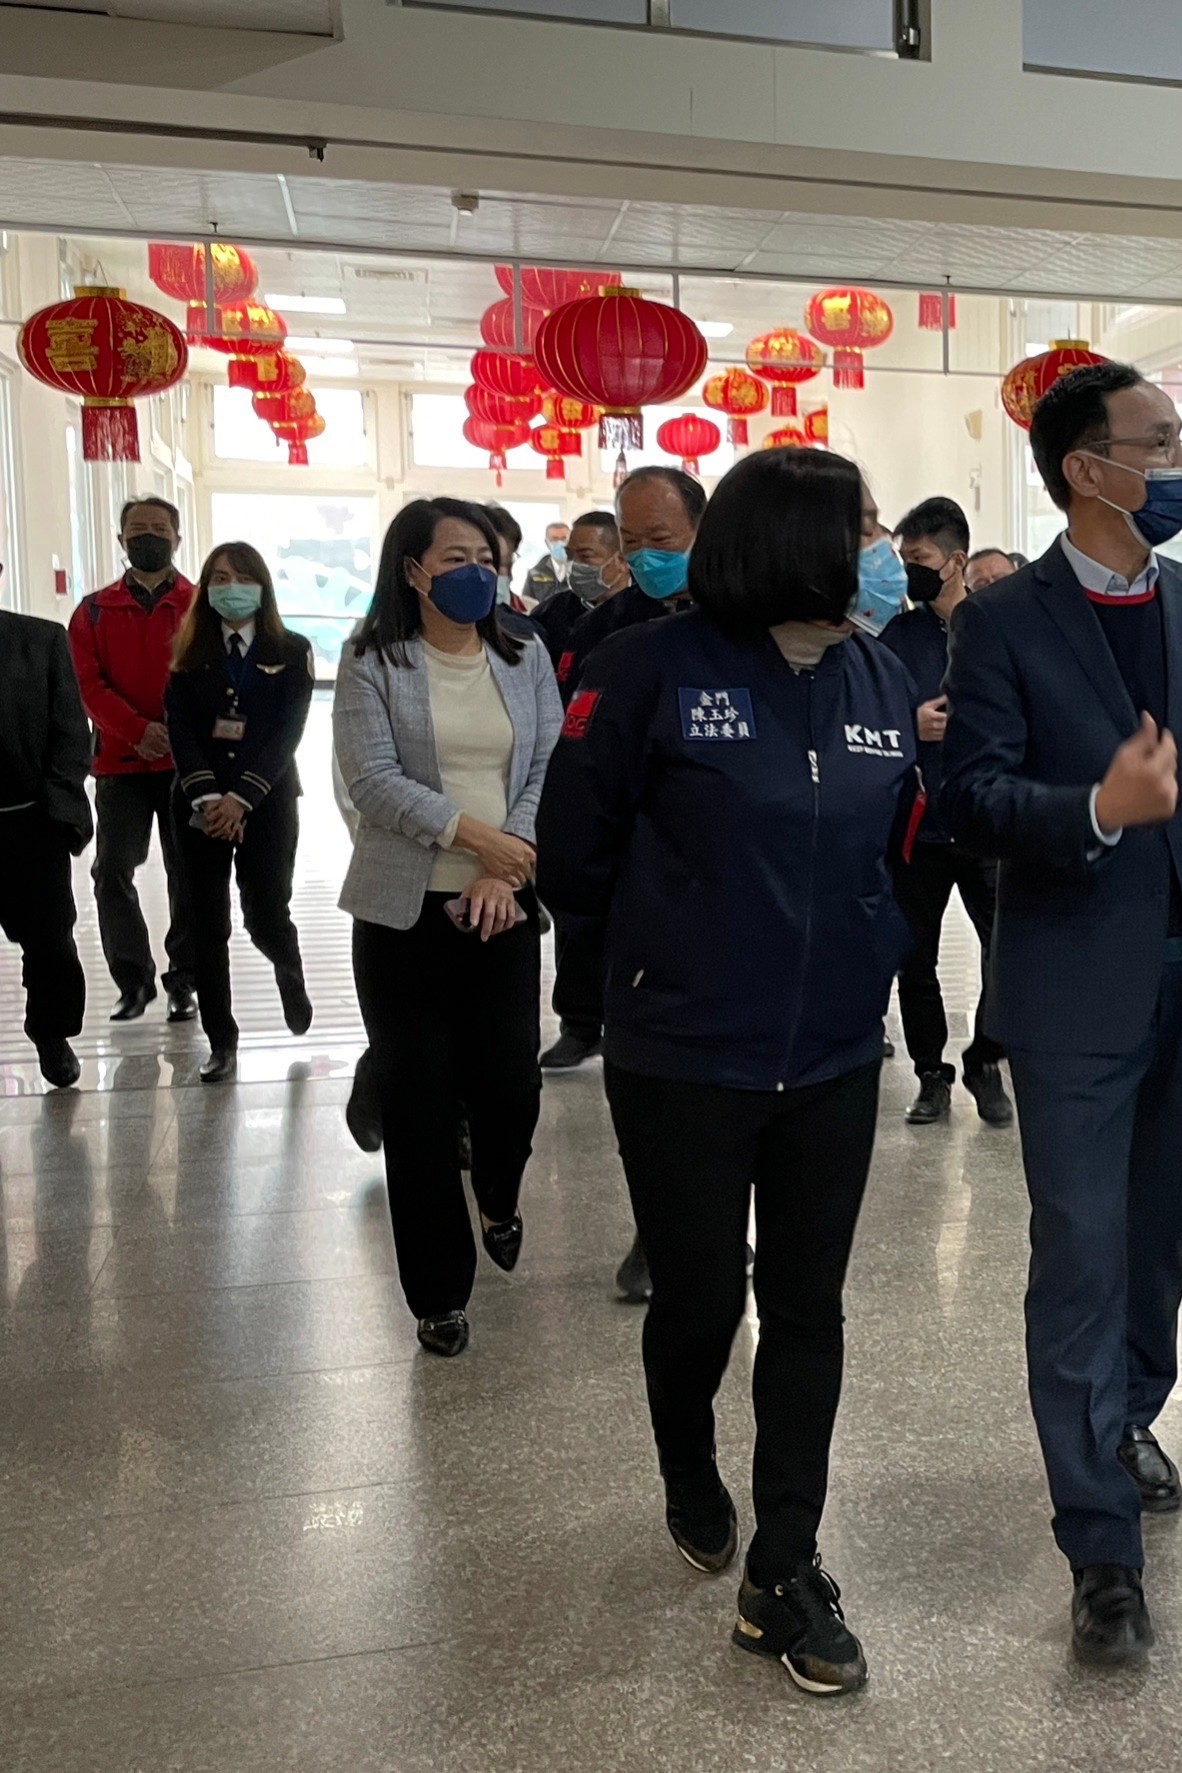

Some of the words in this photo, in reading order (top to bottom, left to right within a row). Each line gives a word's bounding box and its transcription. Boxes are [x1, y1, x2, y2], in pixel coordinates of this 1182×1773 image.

[700, 690, 730, 706] 金門
[689, 721, 750, 738] 立法委員
[844, 724, 901, 748] KMT
